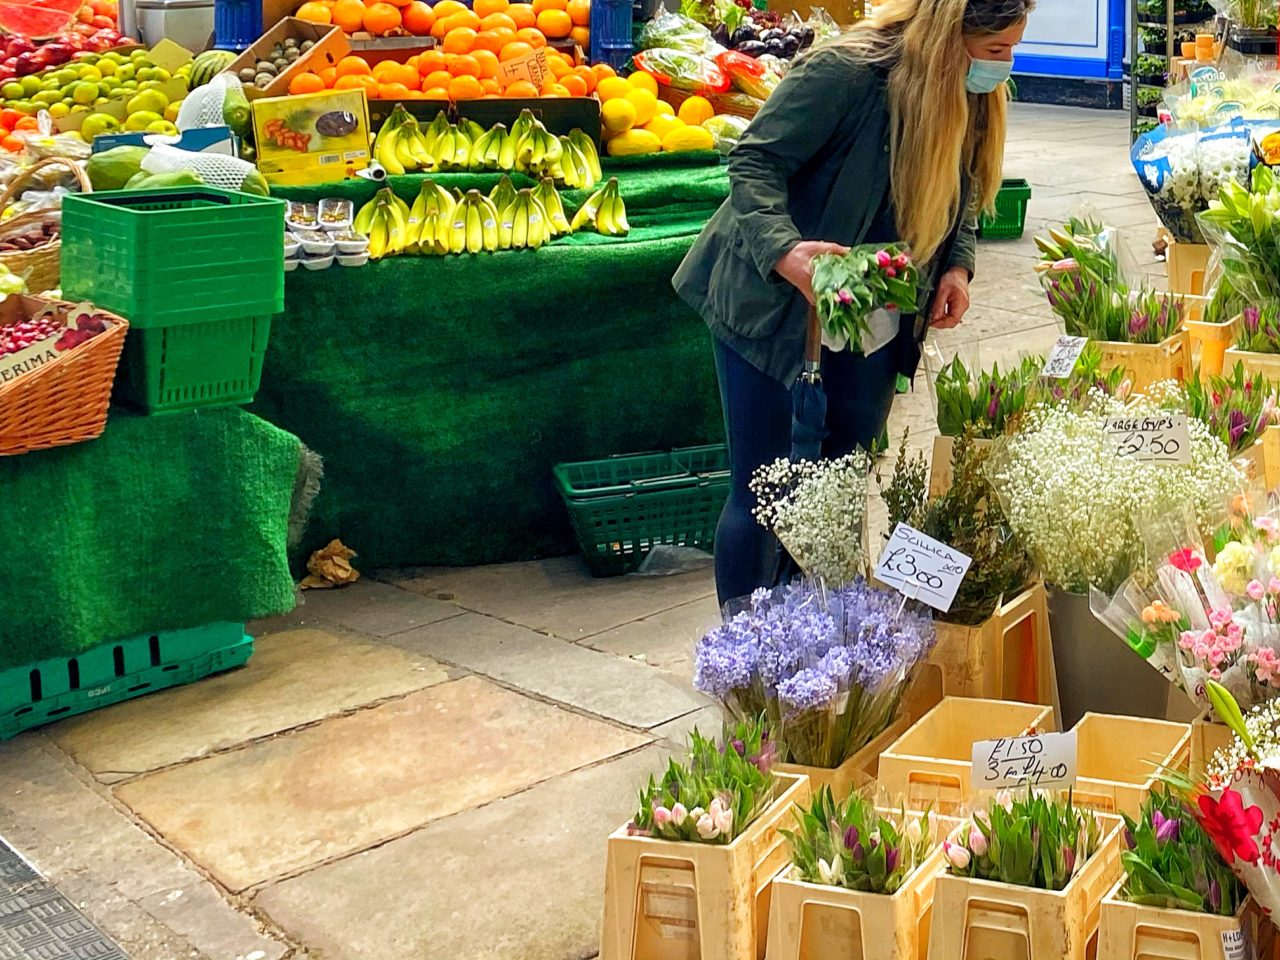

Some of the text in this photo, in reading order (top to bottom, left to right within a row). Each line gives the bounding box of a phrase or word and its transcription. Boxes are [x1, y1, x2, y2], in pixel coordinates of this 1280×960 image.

[1114, 432, 1179, 457] £2.50
[988, 738, 1043, 762] £1.50
[985, 761, 1000, 781] 3
[1022, 755, 1068, 785] £4.00
